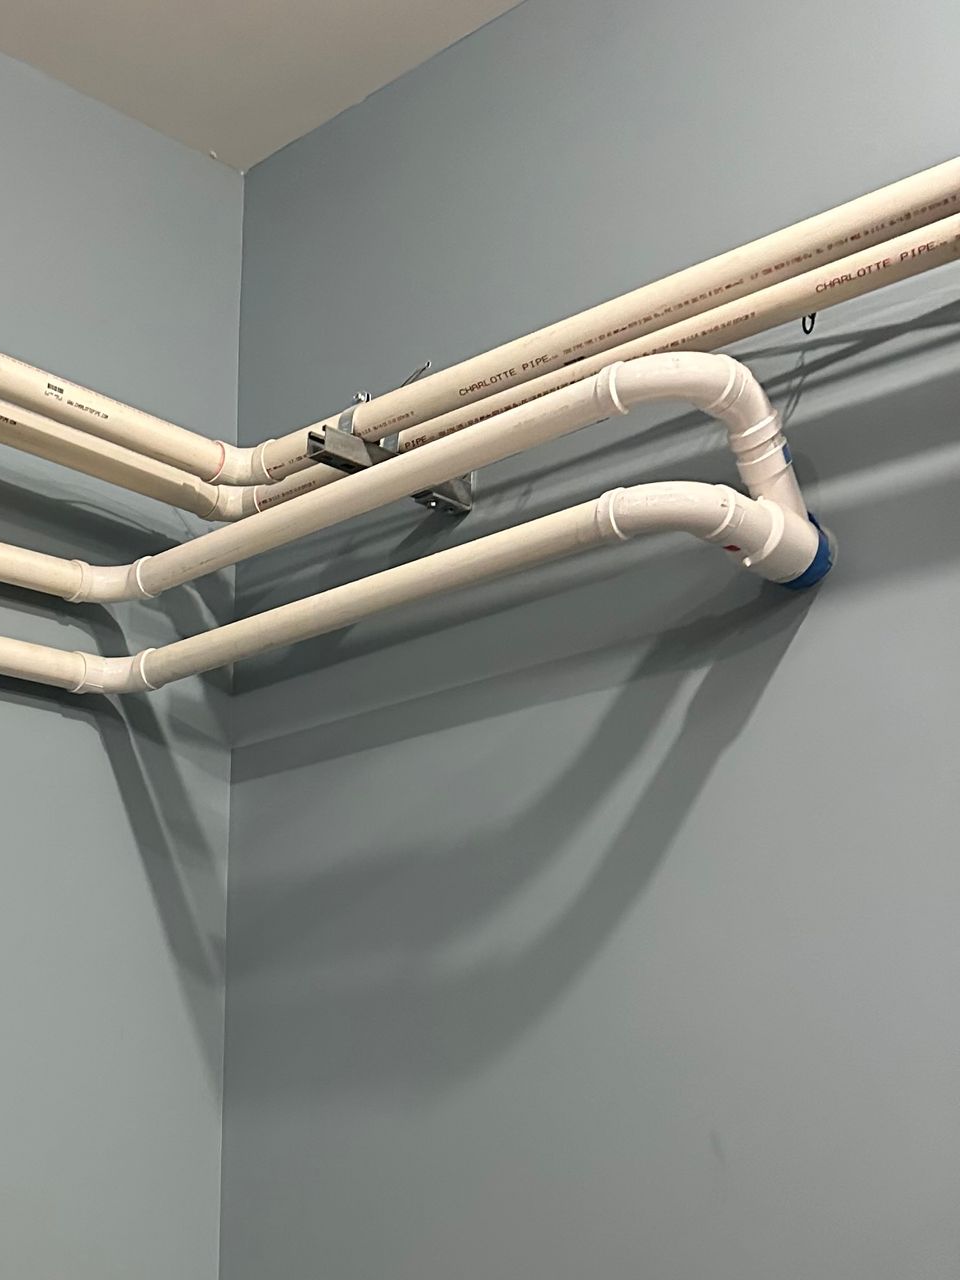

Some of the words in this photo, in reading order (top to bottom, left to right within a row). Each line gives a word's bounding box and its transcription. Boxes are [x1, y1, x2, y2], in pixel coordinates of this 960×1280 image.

[815, 258, 892, 293] CHARLOTTE
[900, 241, 937, 261] PIPE
[458, 368, 517, 396] CHARLOTTE
[522, 354, 551, 371] PIPE
[404, 435, 427, 449] PIPE
